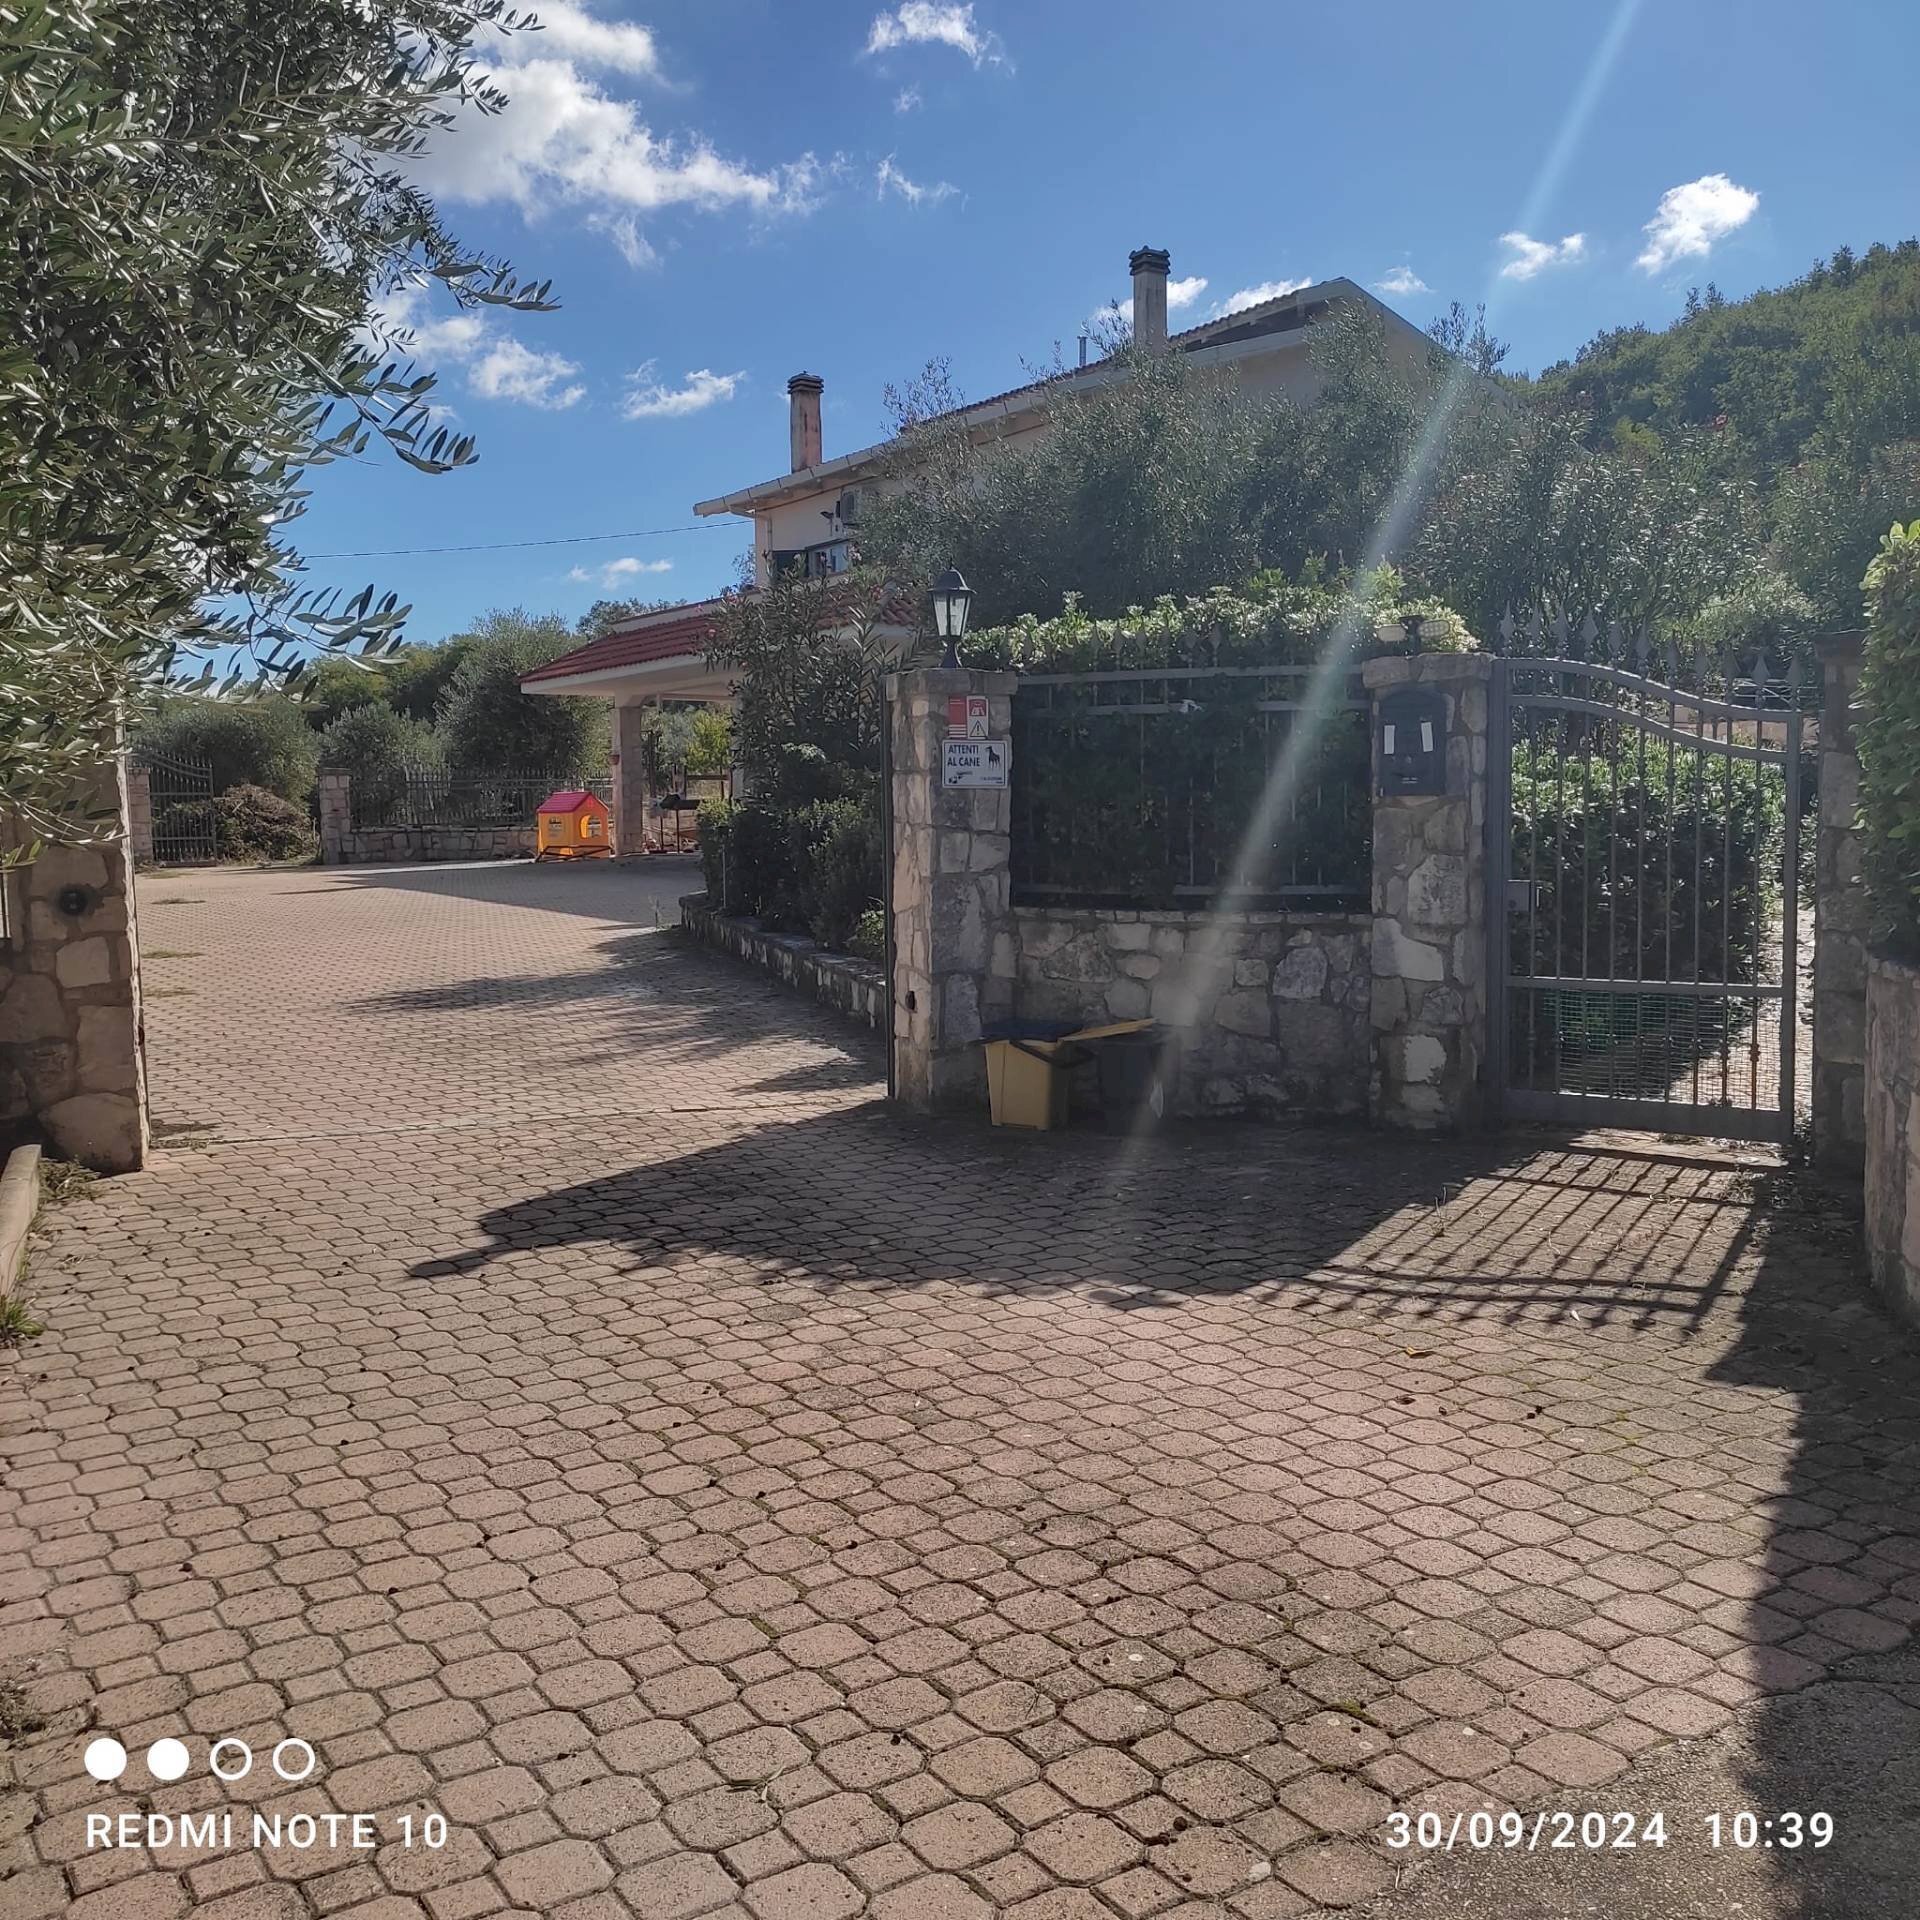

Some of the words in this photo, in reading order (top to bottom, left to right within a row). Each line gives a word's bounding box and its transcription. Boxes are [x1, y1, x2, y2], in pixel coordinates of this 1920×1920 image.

[948, 745, 979, 754] ATTENTI
[947, 757, 957, 767] AL
[958, 757, 981, 767] CANE
